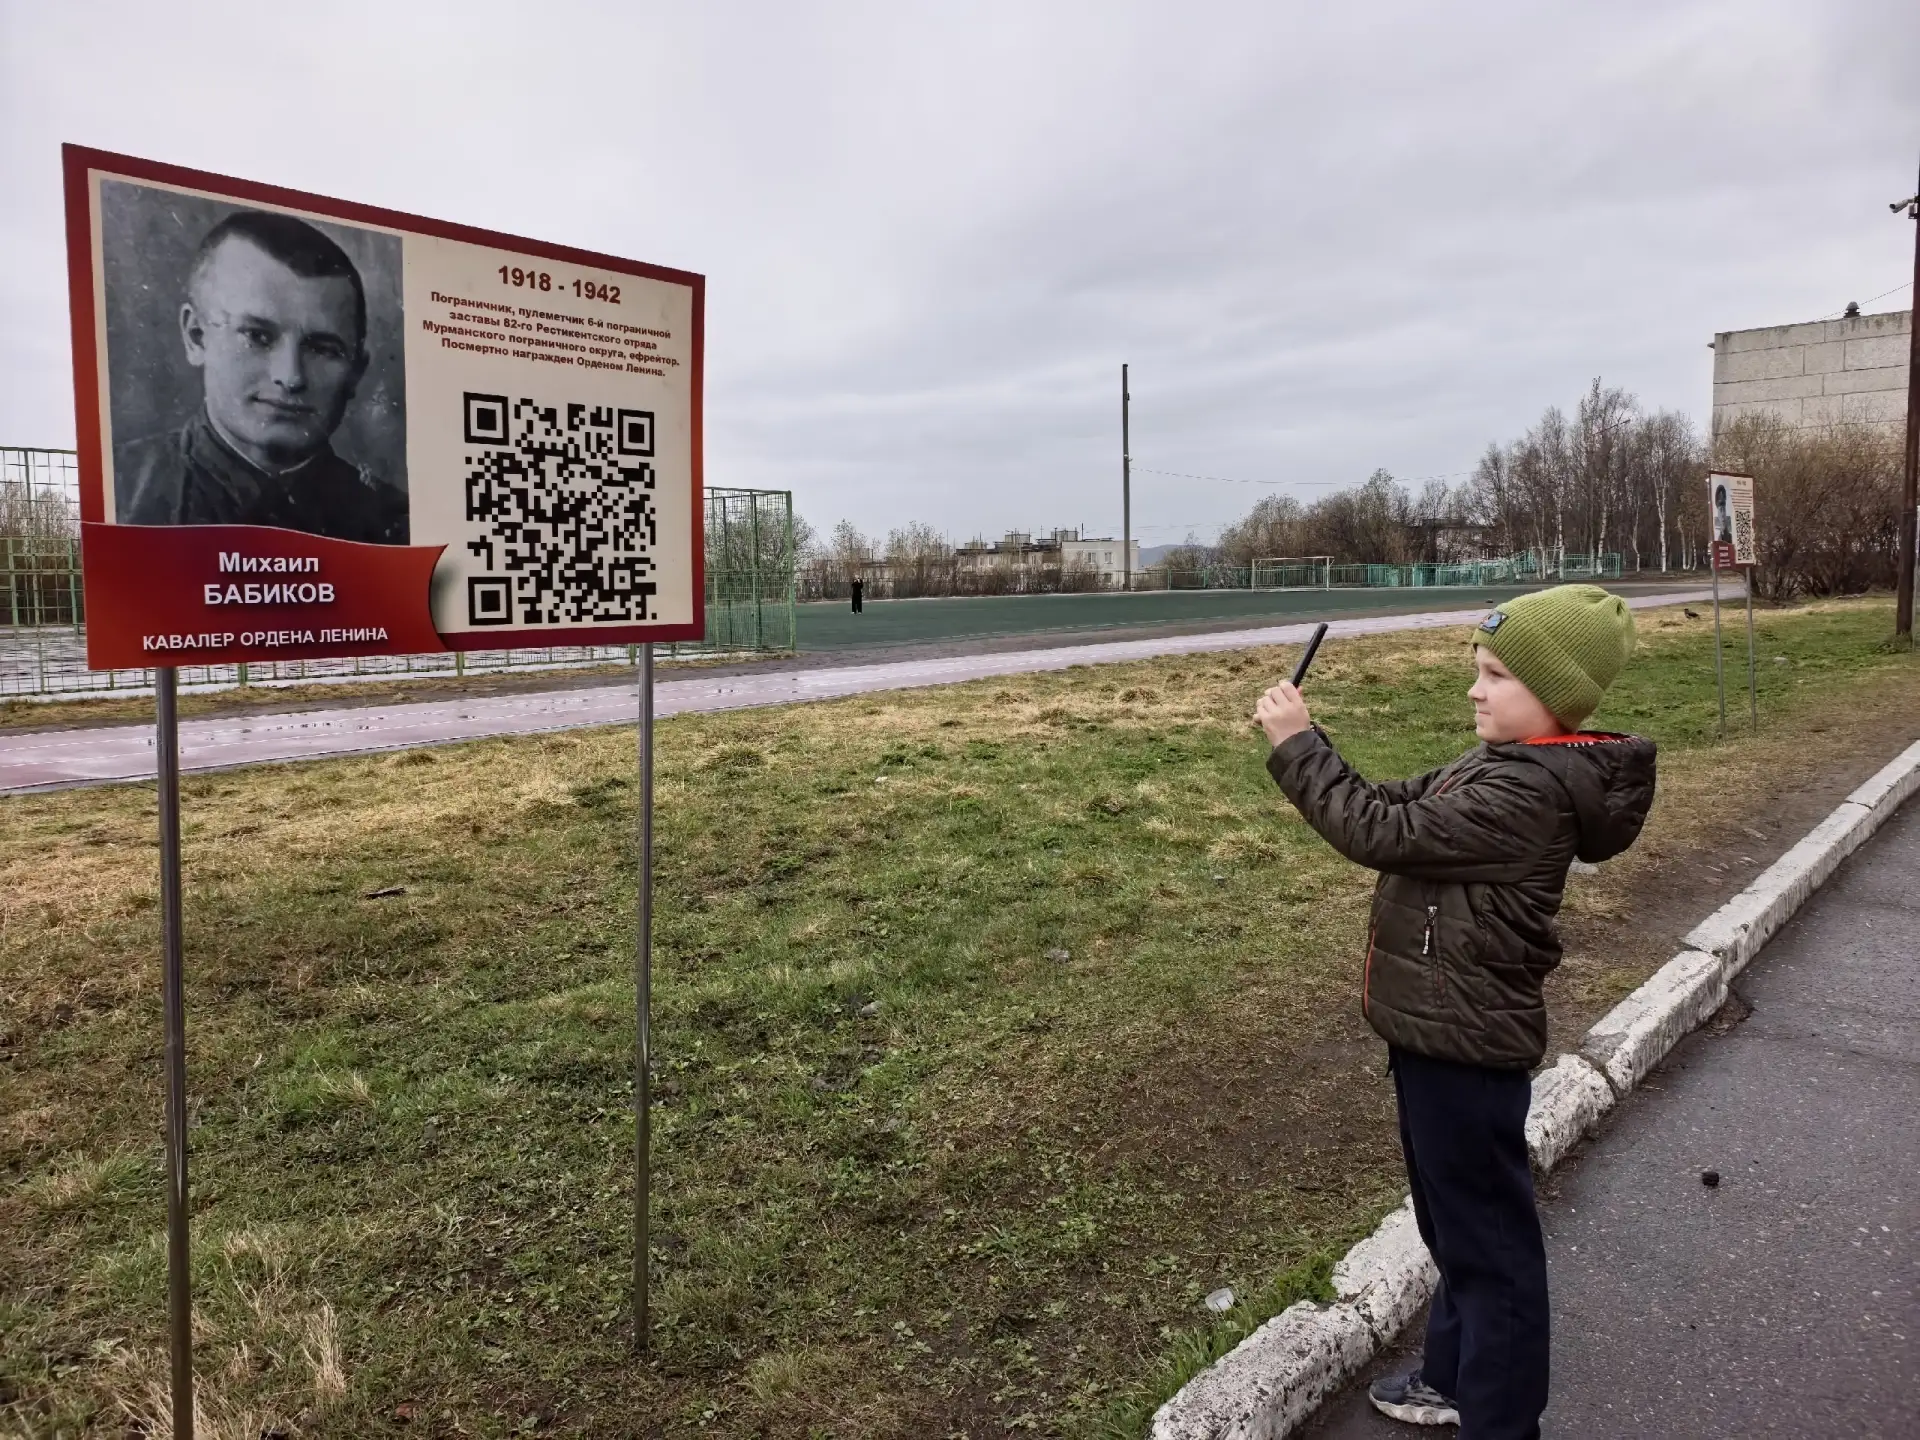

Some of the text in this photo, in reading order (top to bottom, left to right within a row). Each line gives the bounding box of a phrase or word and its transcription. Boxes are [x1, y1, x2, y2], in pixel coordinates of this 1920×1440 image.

[498, 265, 551, 291] 1918
[572, 280, 621, 304] 1942
[431, 291, 671, 339] Пограничник, пулеметчик 6-й пограничной
[449, 312, 500, 326] заставы
[536, 323, 621, 344] Рестикентского
[624, 338, 657, 351] отряда
[423, 320, 680, 367] Мурманского пограничного округа, ефрейтор.
[442, 339, 666, 377] Посмертно награжден Орденом Ленина.
[218, 552, 319, 573] Михаил
[204, 583, 335, 605] БАБИКОВ
[143, 627, 388, 650] КАВАЛЕР ОРДЕНА ЛЕНИНА
